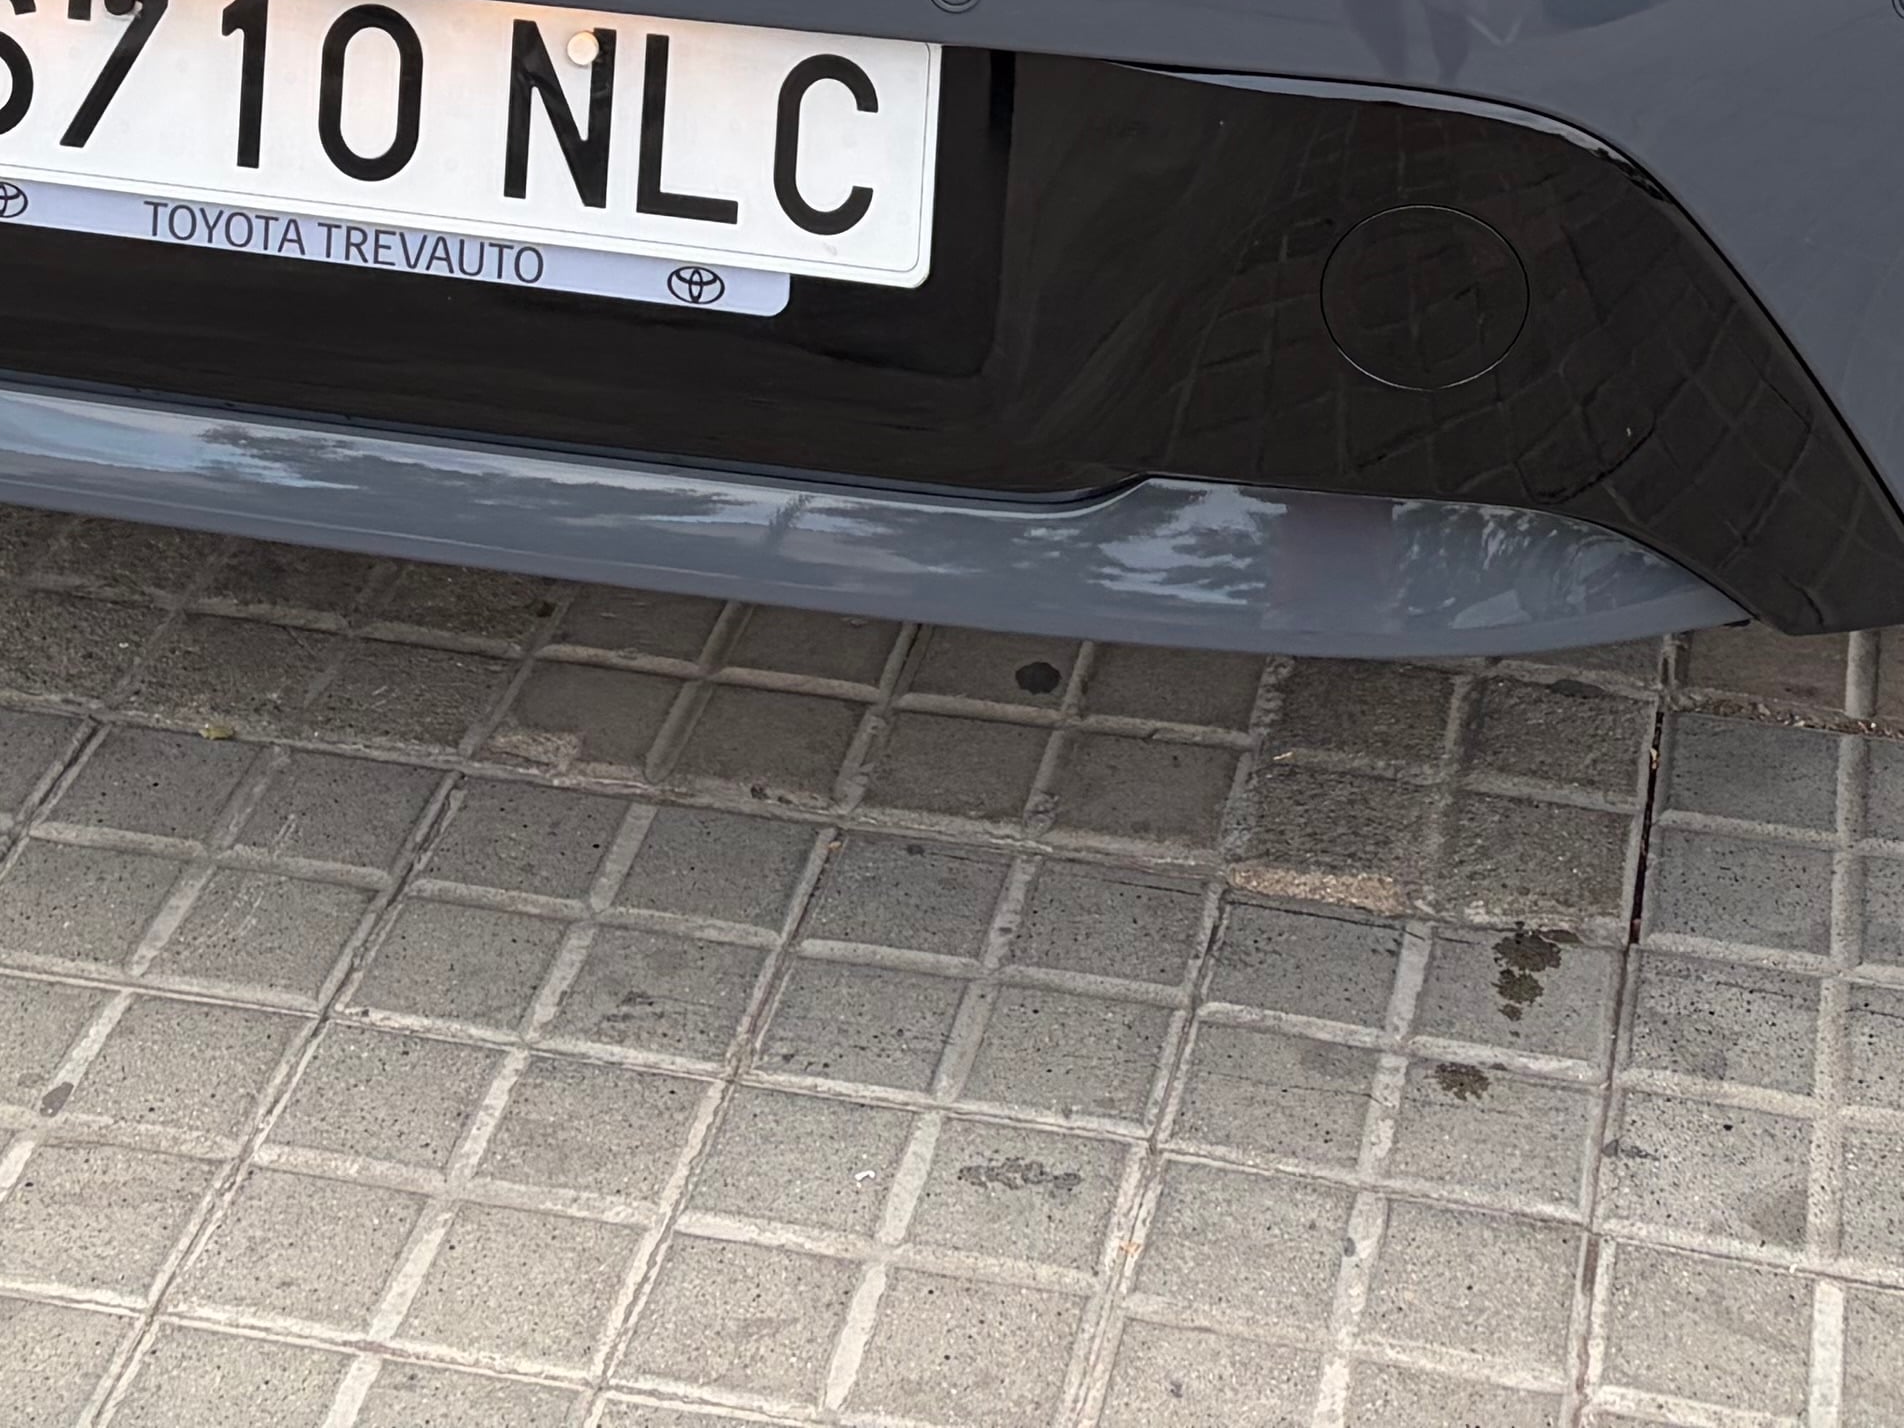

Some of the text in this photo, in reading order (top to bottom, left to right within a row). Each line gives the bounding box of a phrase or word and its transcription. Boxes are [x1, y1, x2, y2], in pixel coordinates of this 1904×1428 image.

[502, 18, 879, 236] NLC
[143, 200, 545, 284] TOYOTA TREVAUTO
